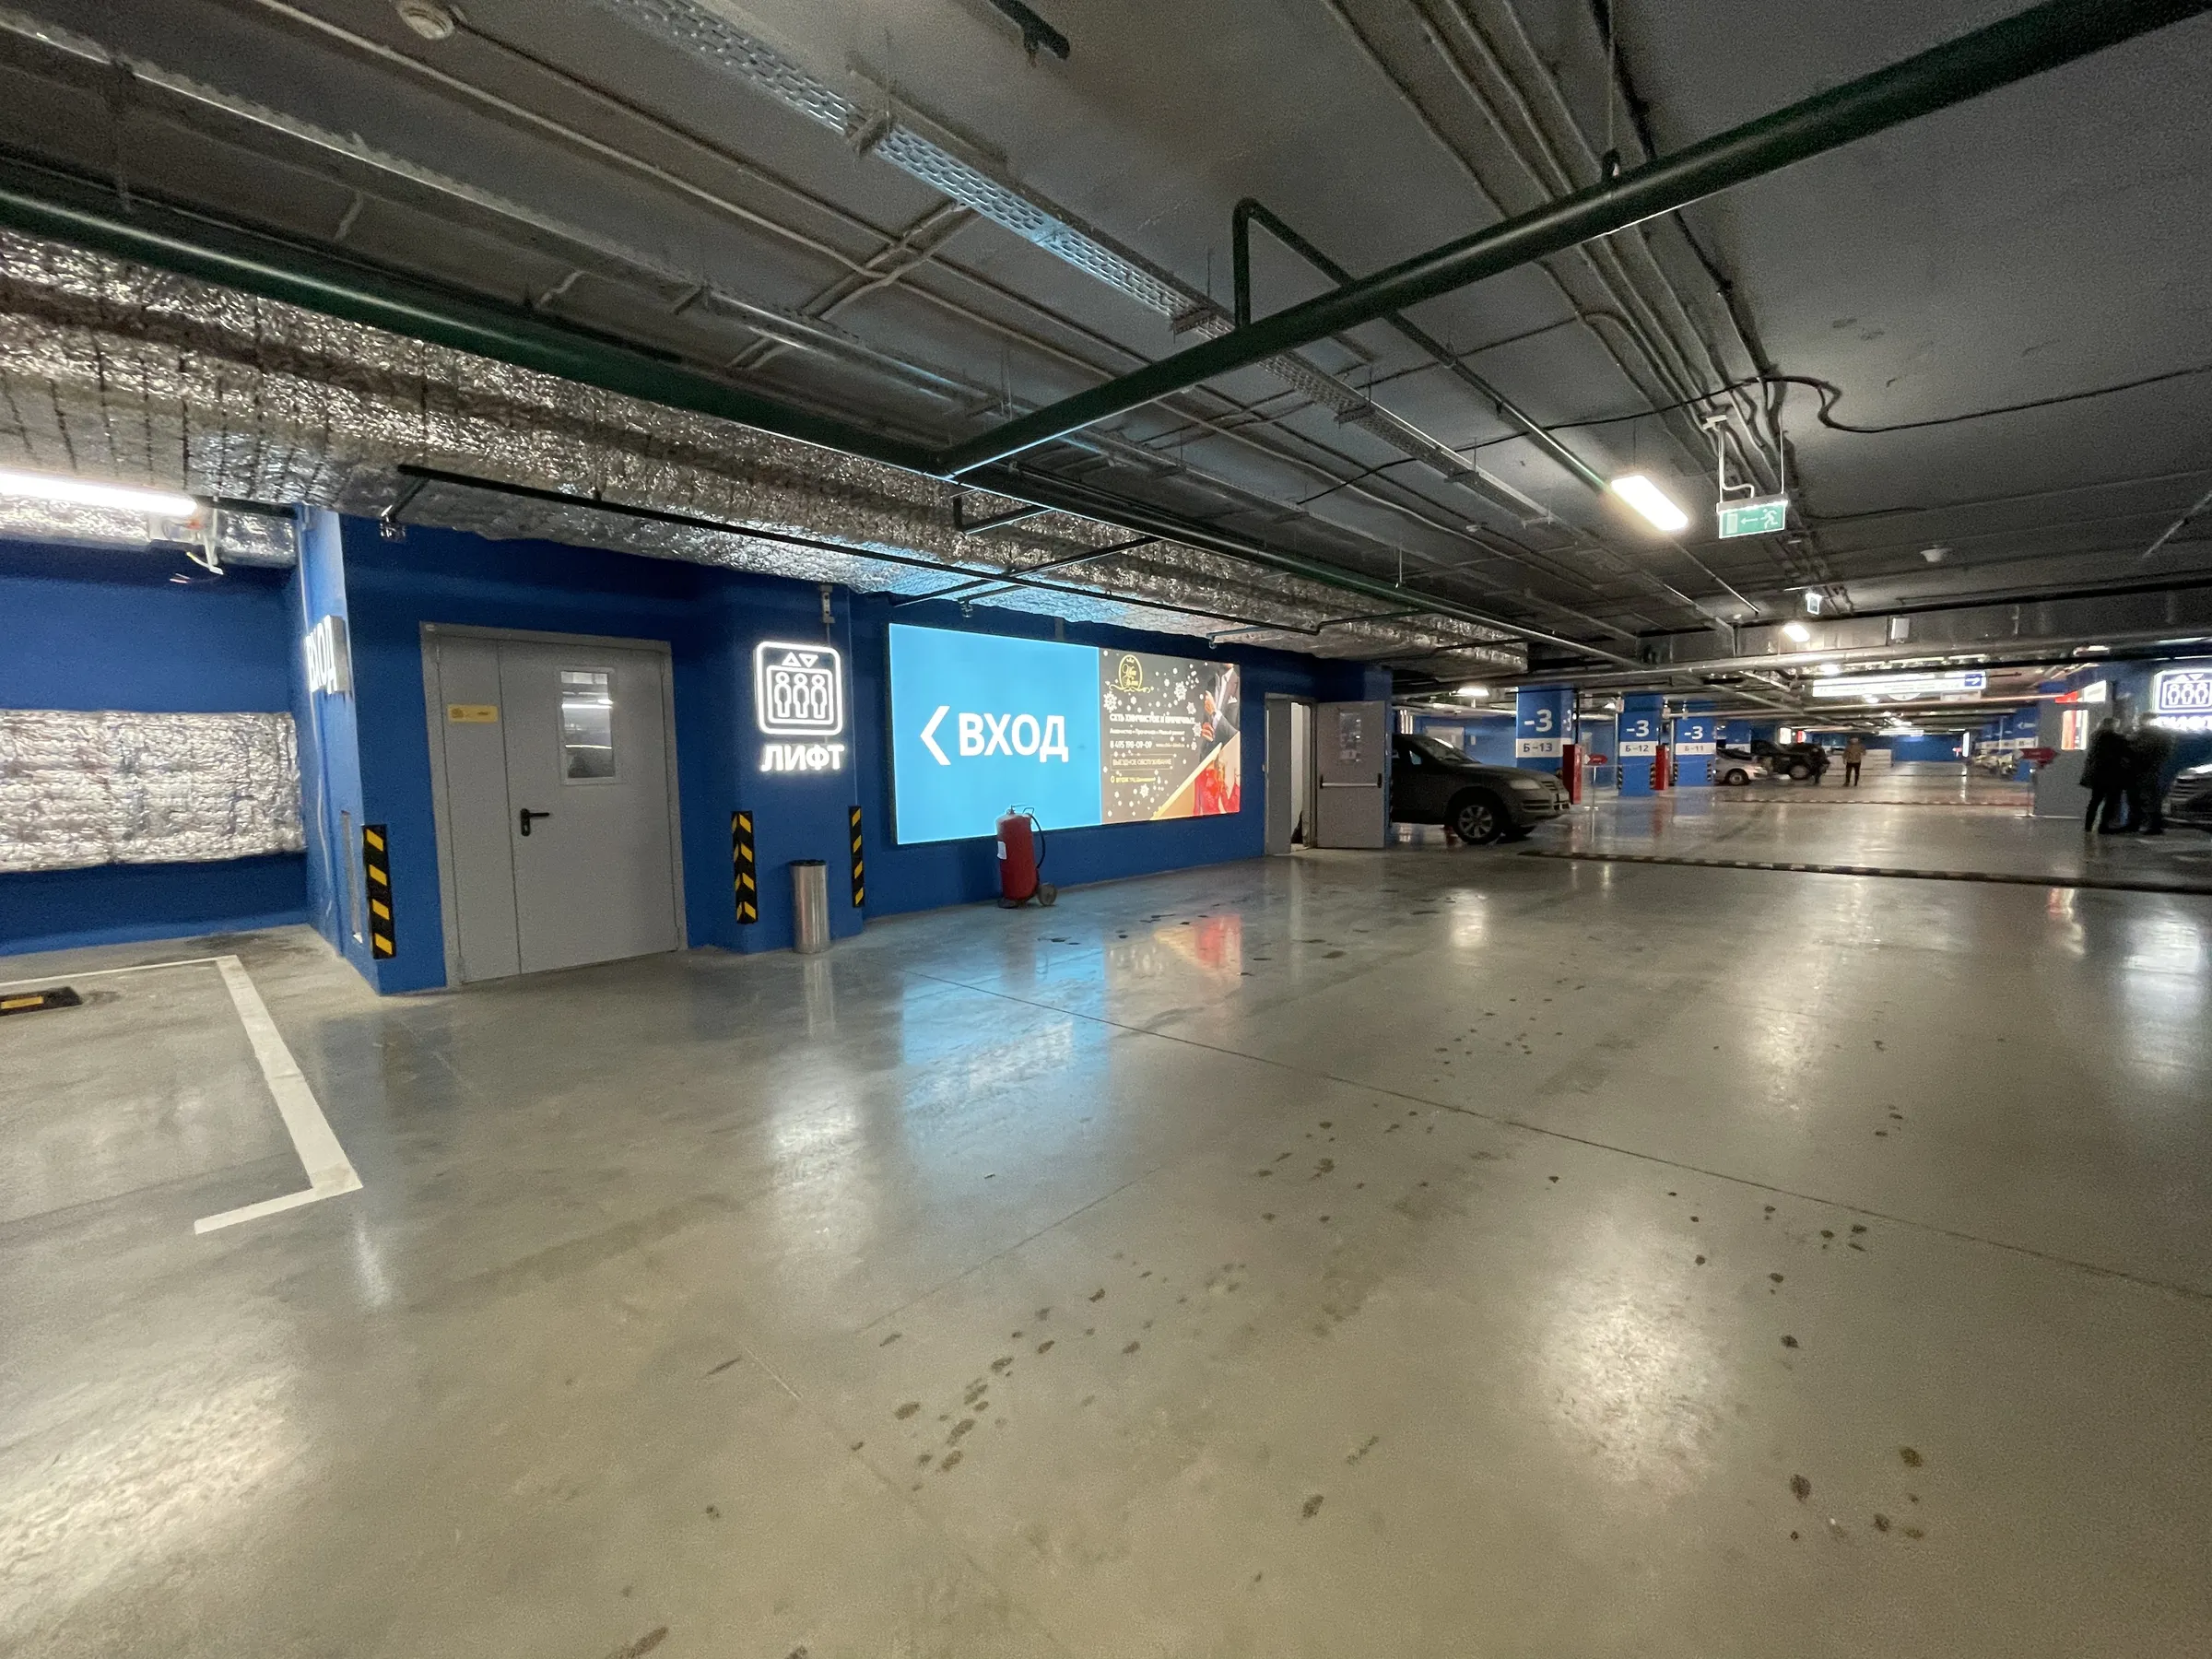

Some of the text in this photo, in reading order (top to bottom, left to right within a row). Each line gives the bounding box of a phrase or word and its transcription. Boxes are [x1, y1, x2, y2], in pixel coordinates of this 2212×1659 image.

[1524, 709, 1553, 732] -3
[1626, 720, 1650, 737] -3
[959, 712, 1069, 763] ВХОД
[1684, 725, 1703, 740] -3
[1523, 742, 1553, 753] Б-13
[1625, 745, 1649, 753] Б-12
[759, 743, 846, 771] ЛИФТ
